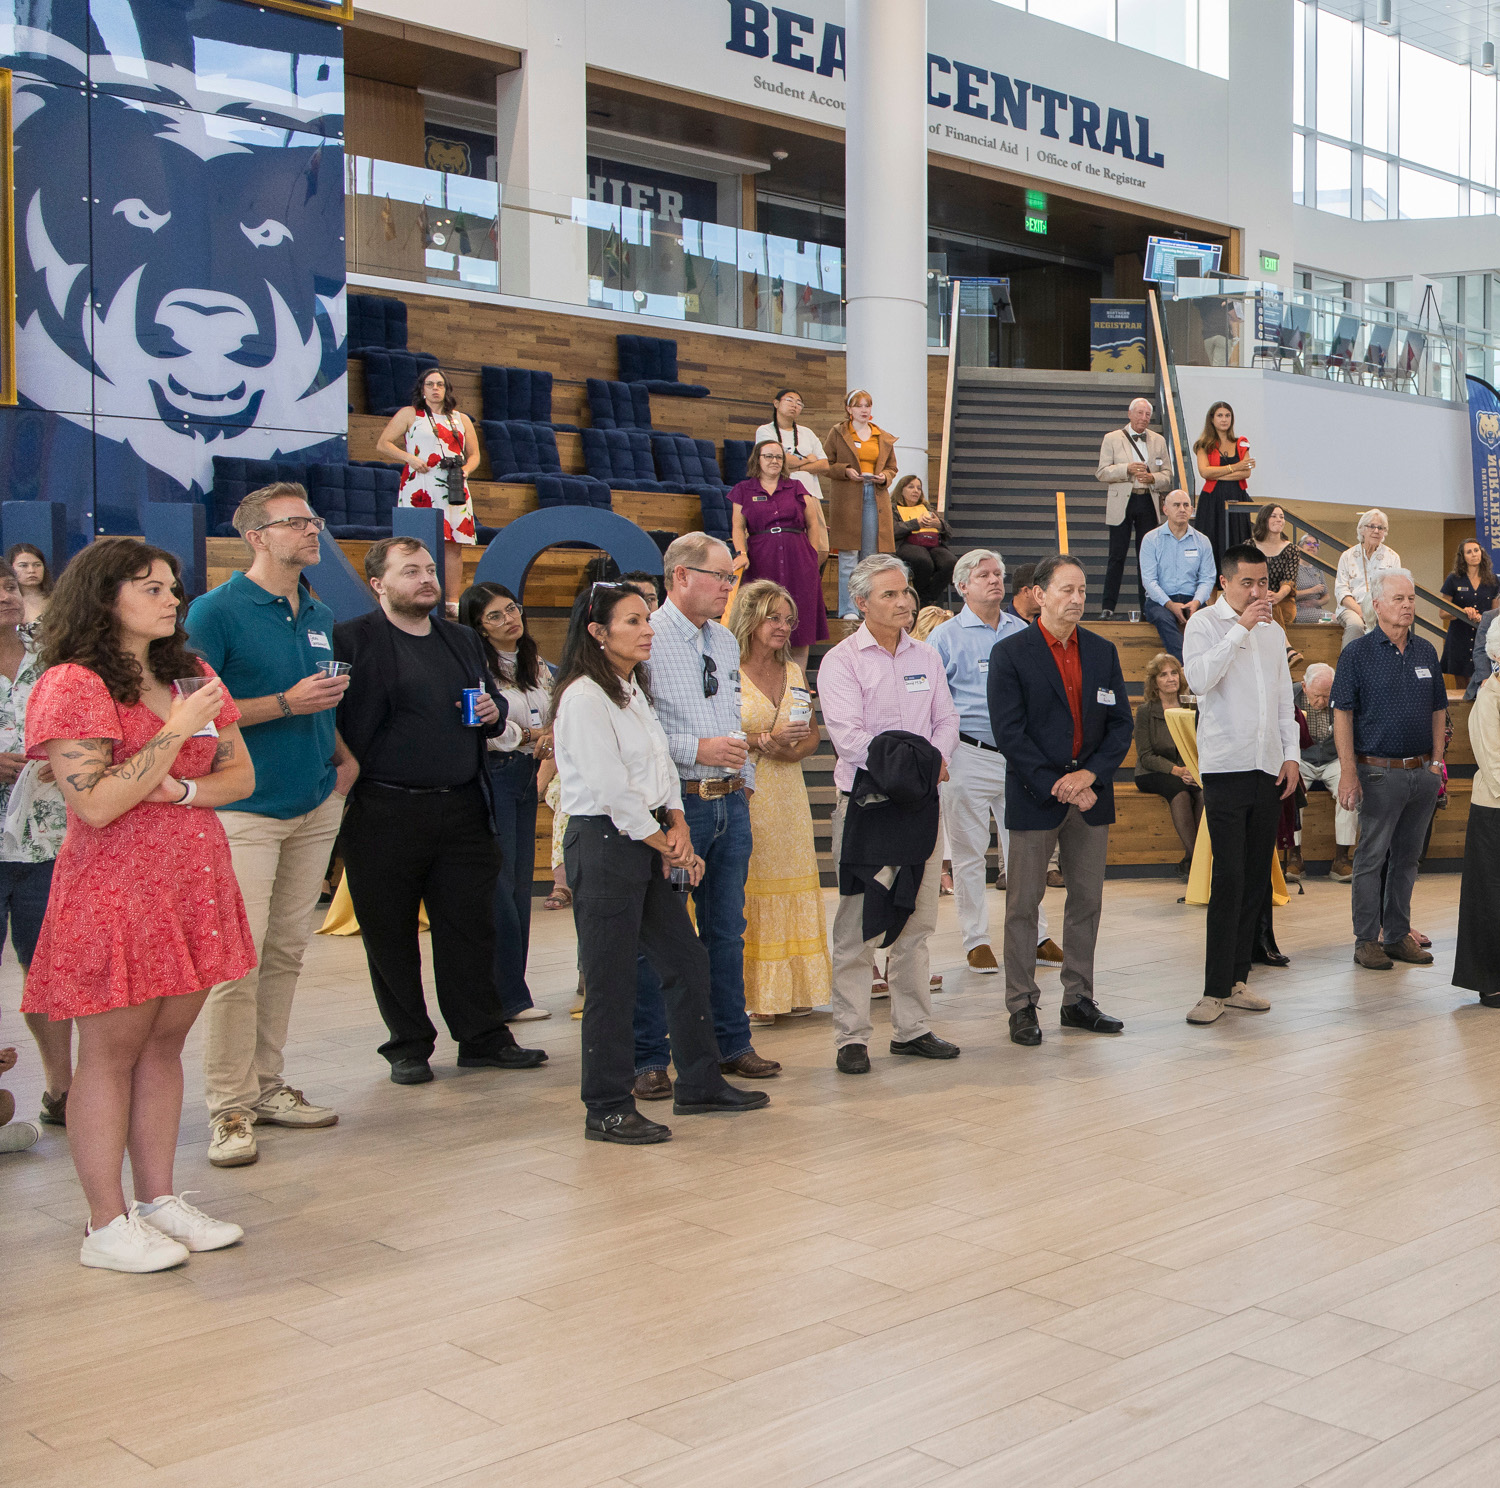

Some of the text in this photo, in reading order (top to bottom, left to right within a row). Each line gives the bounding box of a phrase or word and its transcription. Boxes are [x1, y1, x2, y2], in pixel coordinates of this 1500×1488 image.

[726, 0, 1165, 169] BEA CENTRAL
[753, 75, 805, 100] Student
[808, 90, 846, 111] Accou
[928, 124, 942, 135] of
[945, 125, 997, 150] Financial
[1000, 139, 1019, 155] Aid
[1036, 150, 1068, 168] Office
[1070, 160, 1084, 172] of
[1085, 163, 1101, 177] the
[1103, 167, 1147, 189] Registrar
[1029, 217, 1044, 233] EXIT
[1265, 256, 1277, 271] EXIT
